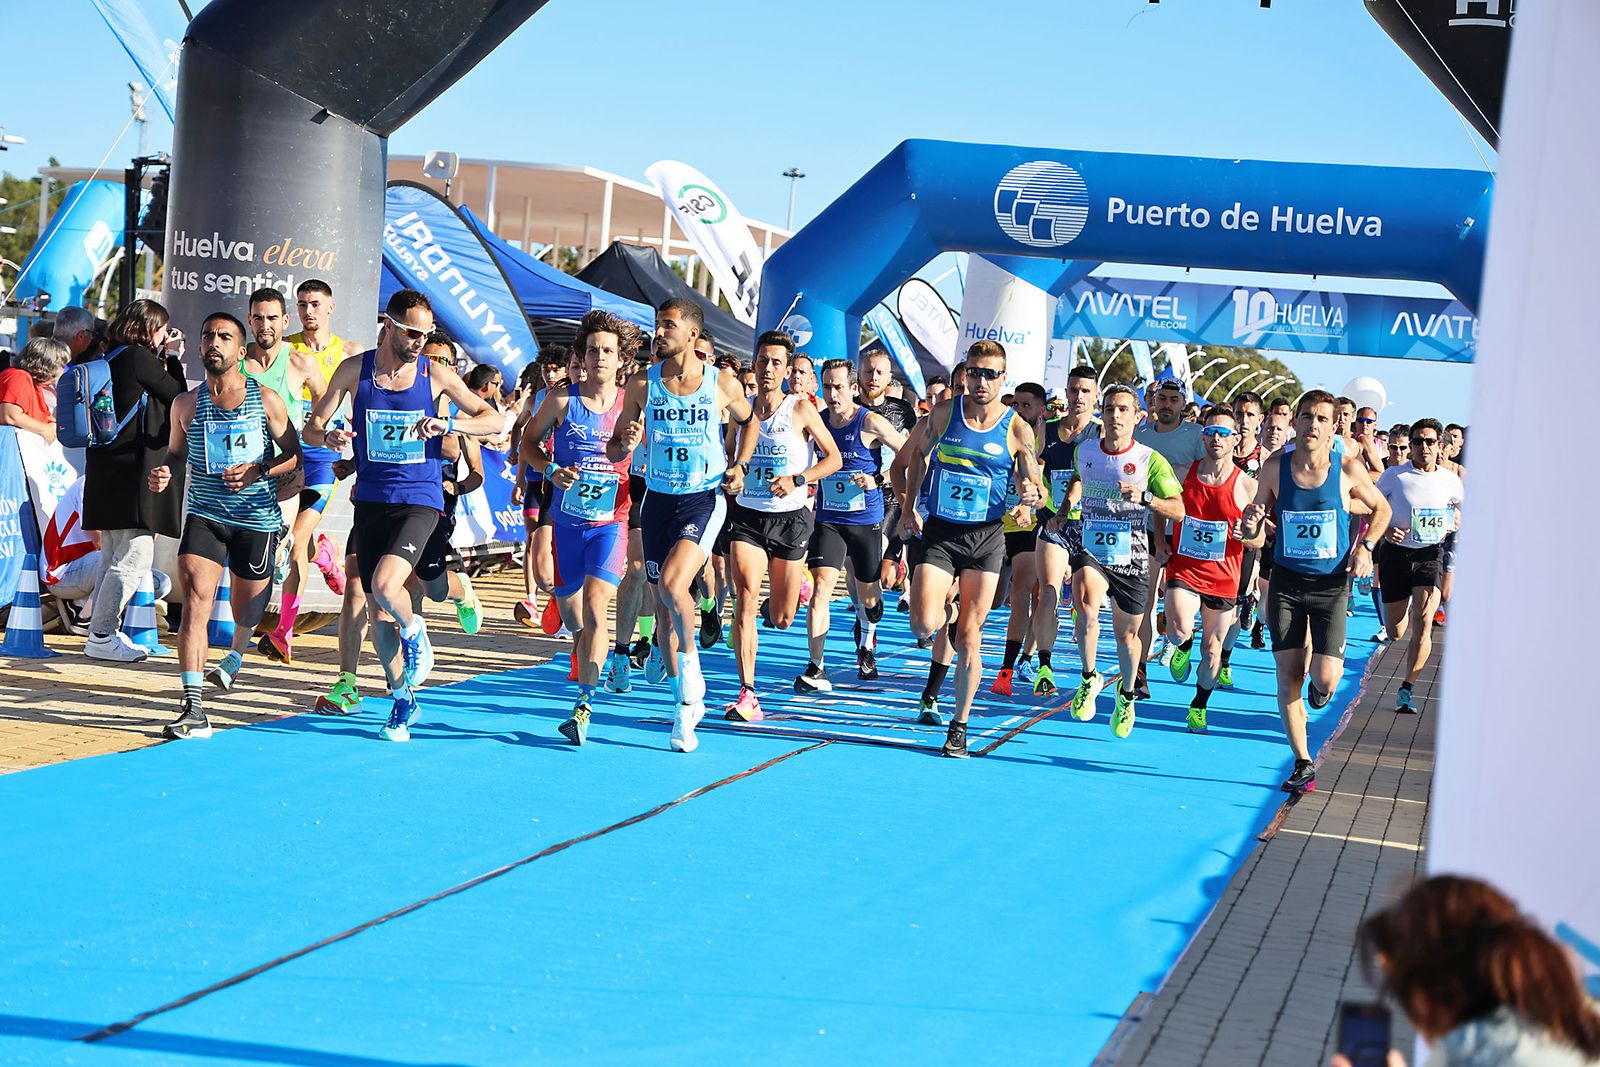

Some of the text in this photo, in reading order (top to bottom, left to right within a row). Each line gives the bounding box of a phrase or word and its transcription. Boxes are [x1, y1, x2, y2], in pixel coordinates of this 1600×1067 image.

[1107, 197, 1383, 237] Puerto de Huelva
[173, 230, 336, 272] Huelva eleva
[171, 266, 298, 300] tus sentid
[1075, 290, 1187, 321] AVATEL
[1274, 303, 1345, 329] HUELVA
[1144, 319, 1187, 330] TELECOM
[964, 321, 1025, 345] Huelva
[653, 404, 709, 426] nerja
[383, 425, 408, 441] 27
[222, 433, 248, 450] 14
[664, 447, 689, 462] 18
[754, 467, 775, 480] 15
[578, 483, 603, 500] 25
[835, 481, 846, 494] 9
[950, 485, 974, 501] 22
[1323, 513, 1334, 521] '24
[1419, 516, 1443, 528] 145
[1095, 532, 1117, 546] 26
[1193, 529, 1213, 544] 35
[1296, 524, 1322, 538] 20
